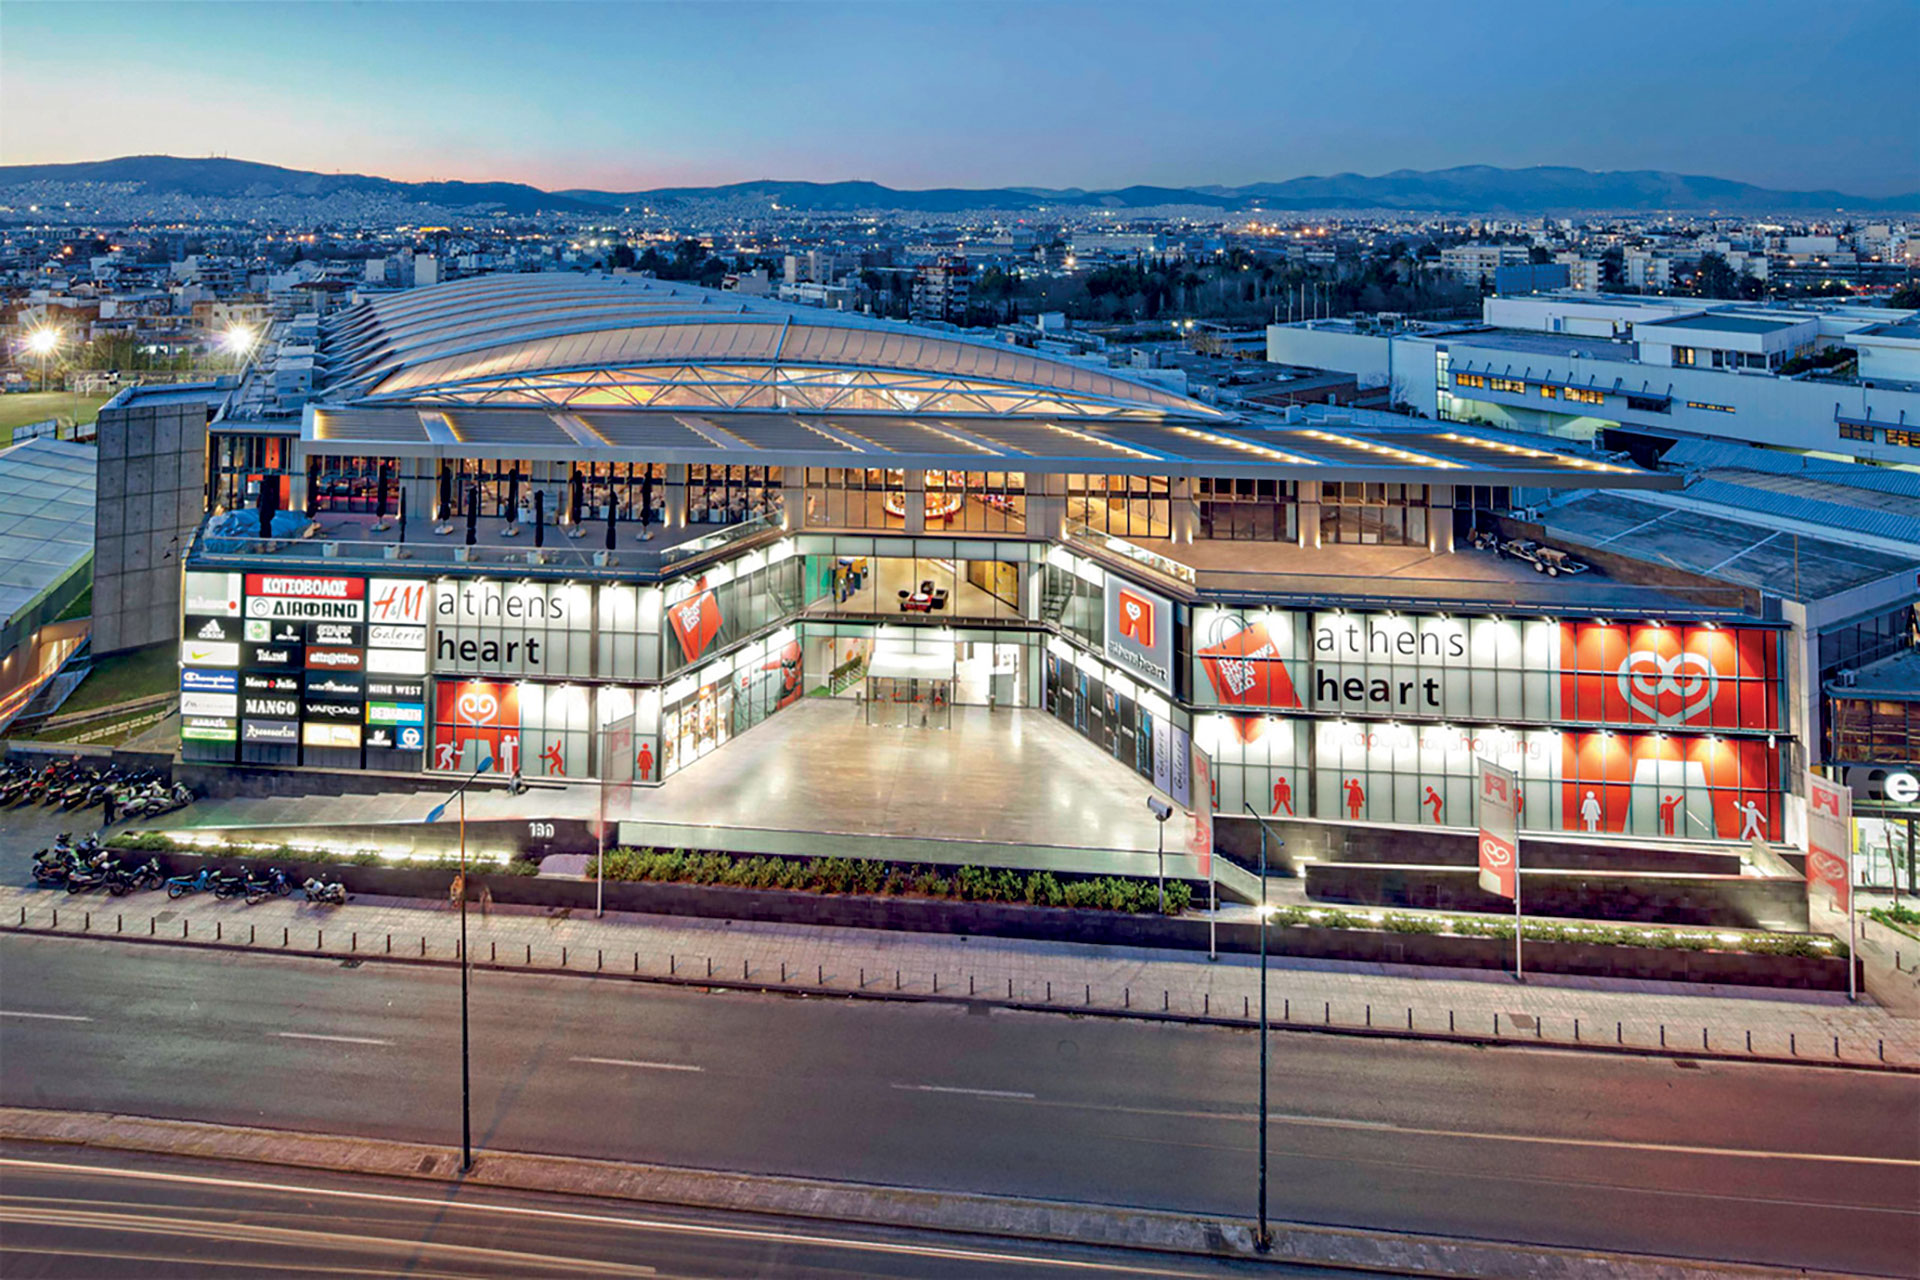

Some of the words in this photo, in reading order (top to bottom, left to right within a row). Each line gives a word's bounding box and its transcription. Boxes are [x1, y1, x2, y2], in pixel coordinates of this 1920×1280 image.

[372, 585, 424, 621] H&M
[438, 586, 563, 619] athens
[371, 626, 424, 641] Galerie
[437, 630, 539, 664] heart
[1317, 621, 1464, 657] athens
[369, 684, 392, 694] NINE
[395, 685, 421, 695] WEST
[1316, 669, 1440, 706] heart
[245, 699, 296, 716] MANGO
